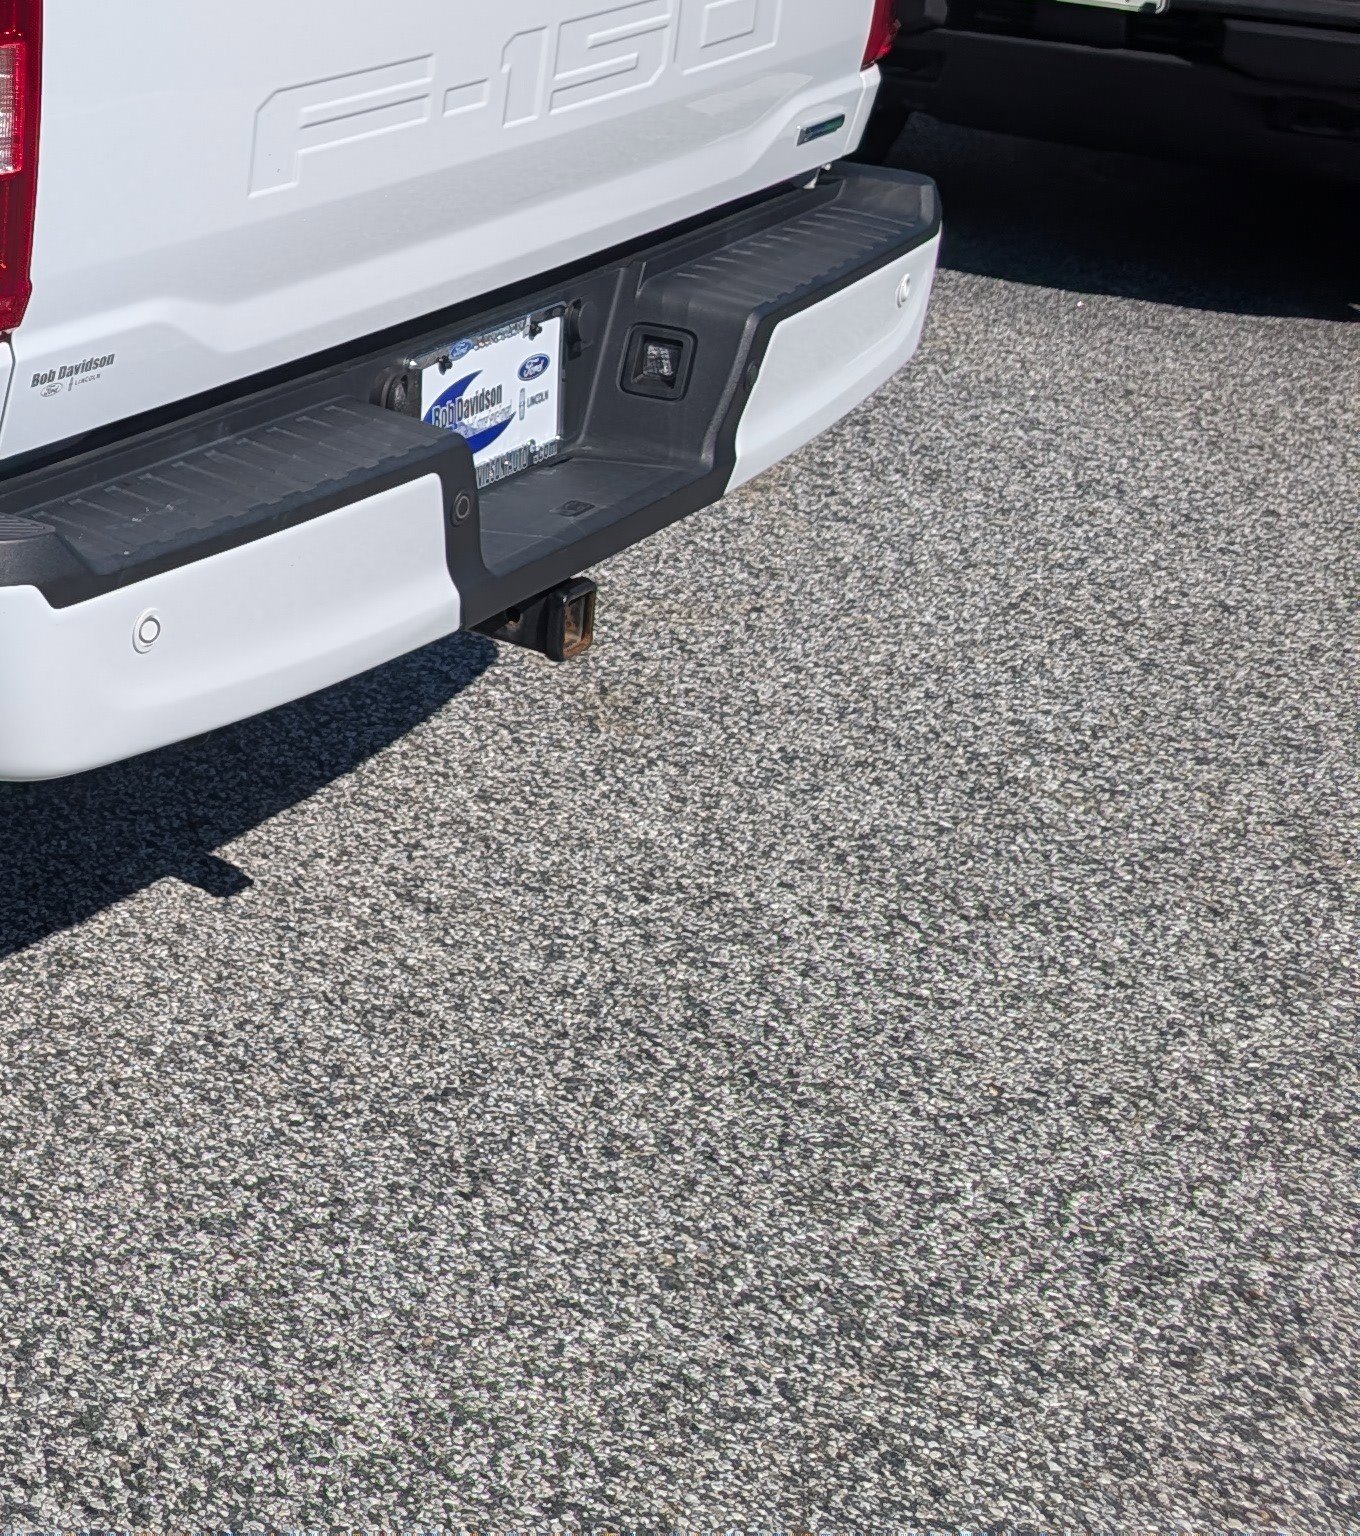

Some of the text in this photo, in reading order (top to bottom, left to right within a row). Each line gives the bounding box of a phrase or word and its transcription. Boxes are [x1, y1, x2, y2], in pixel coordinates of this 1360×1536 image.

[31, 353, 115, 387] Bob Davidson
[74, 373, 101, 385] LINCOLN
[432, 401, 455, 428] Bob
[456, 384, 503, 421] Davidson
[526, 389, 549, 408] LINCOLN
